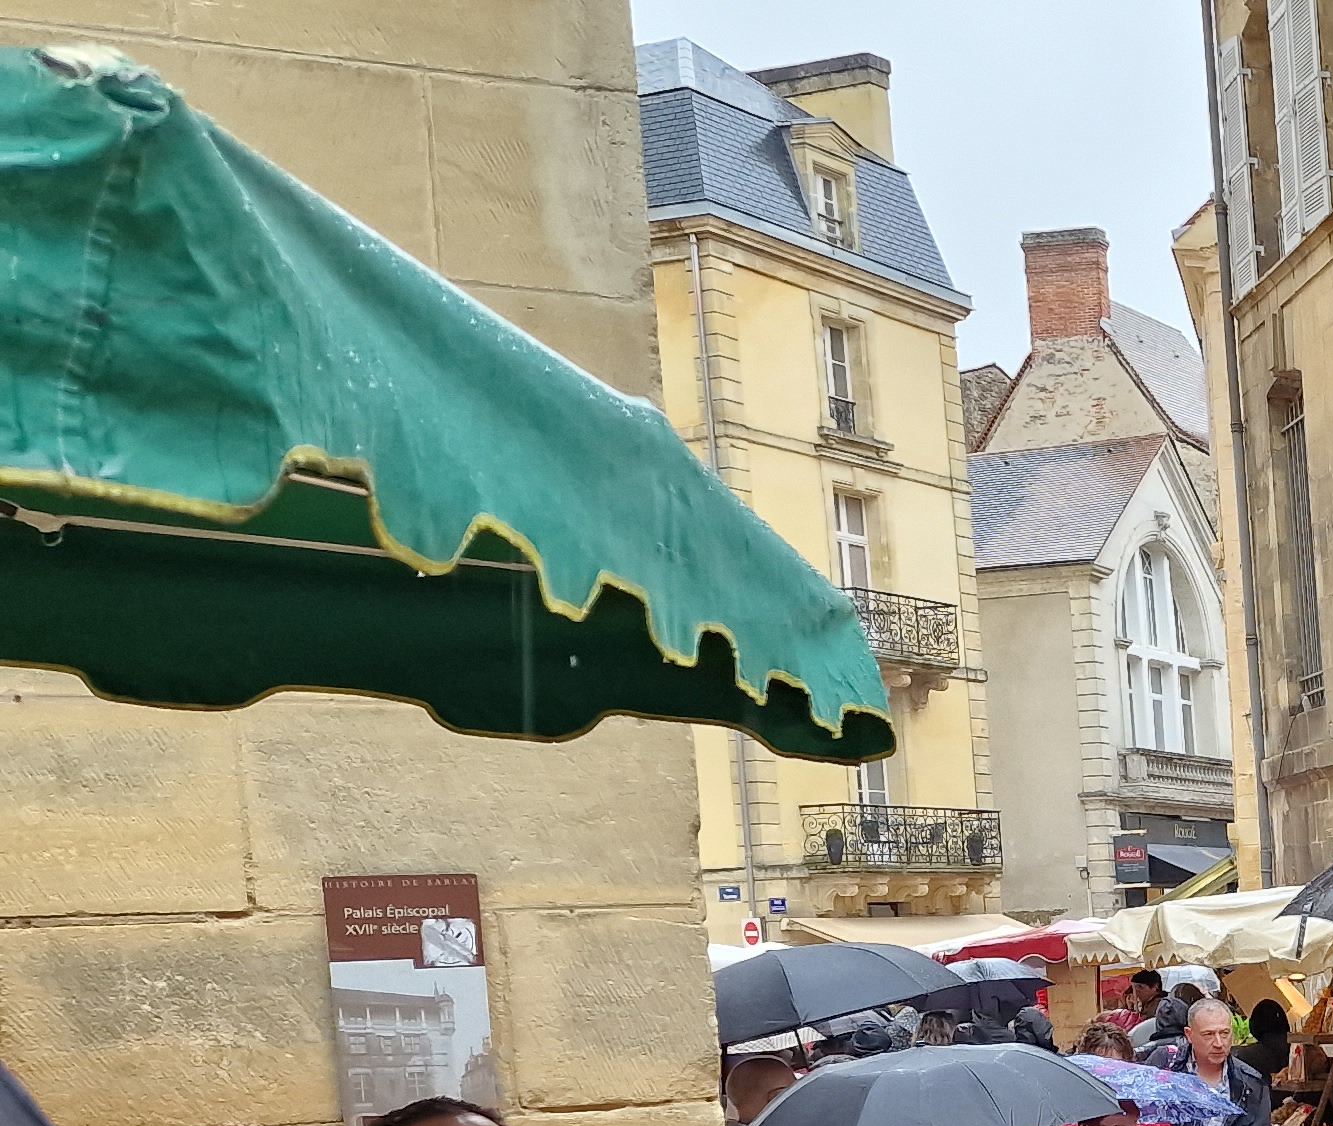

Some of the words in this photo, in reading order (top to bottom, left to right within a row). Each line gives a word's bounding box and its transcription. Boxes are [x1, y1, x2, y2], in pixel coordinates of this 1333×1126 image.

[324, 879, 393, 889] HISTOIRE
[402, 879, 418, 887] DE
[427, 878, 476, 887] SARLAT
[344, 906, 383, 919] Palais
[381, 922, 418, 935] siècle
